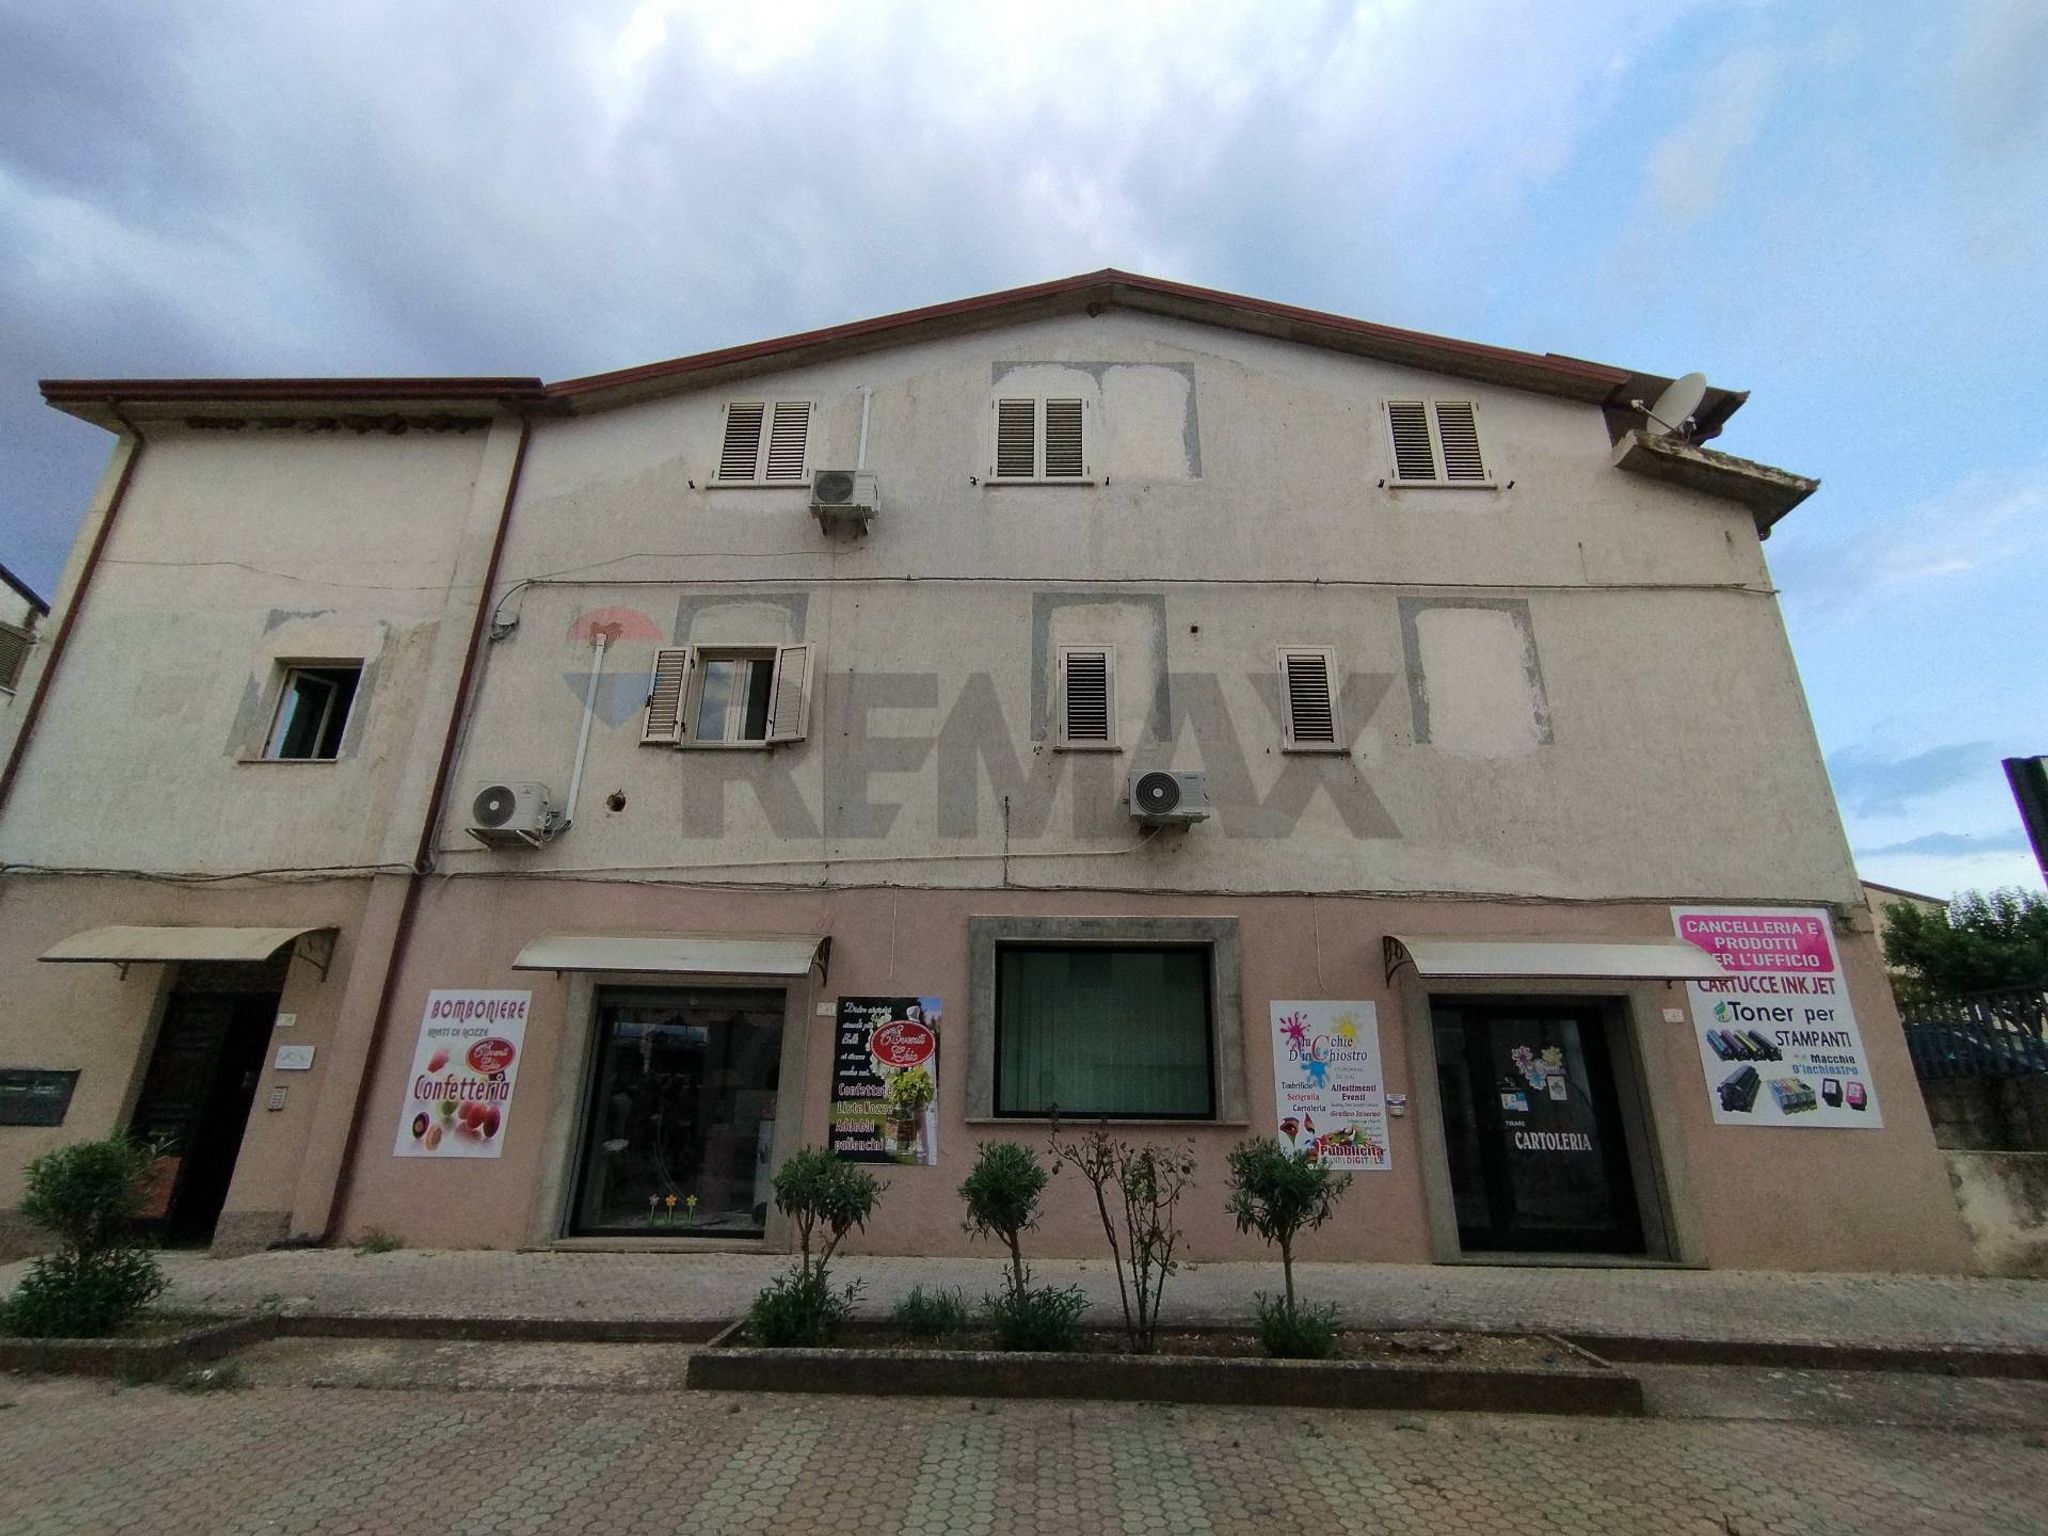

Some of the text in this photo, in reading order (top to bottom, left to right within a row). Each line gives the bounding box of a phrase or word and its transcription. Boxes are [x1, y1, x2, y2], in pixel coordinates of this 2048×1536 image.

[1686, 920, 1818, 934] CANCELLERIA E
[1714, 937, 1798, 950] PRODOTTI
[1712, 953, 1819, 967] ER L'UFFICIO
[1698, 976, 1836, 995] CARTUCCE INK JET
[431, 1000, 526, 1024] BOMBONIERE
[1727, 1001, 1835, 1025] Toner per
[1775, 1031, 1852, 1047] STAMPANTI
[1811, 1054, 1856, 1064] Macchie
[414, 1074, 510, 1100] Confetteria
[1331, 1084, 1377, 1092] Allestimenti
[1341, 1093, 1366, 1101] Eventi
[1292, 1103, 1326, 1112] Cartoleria
[1515, 1131, 1592, 1151] CARTOLERIA
[1346, 1156, 1386, 1165] DIGITLE
